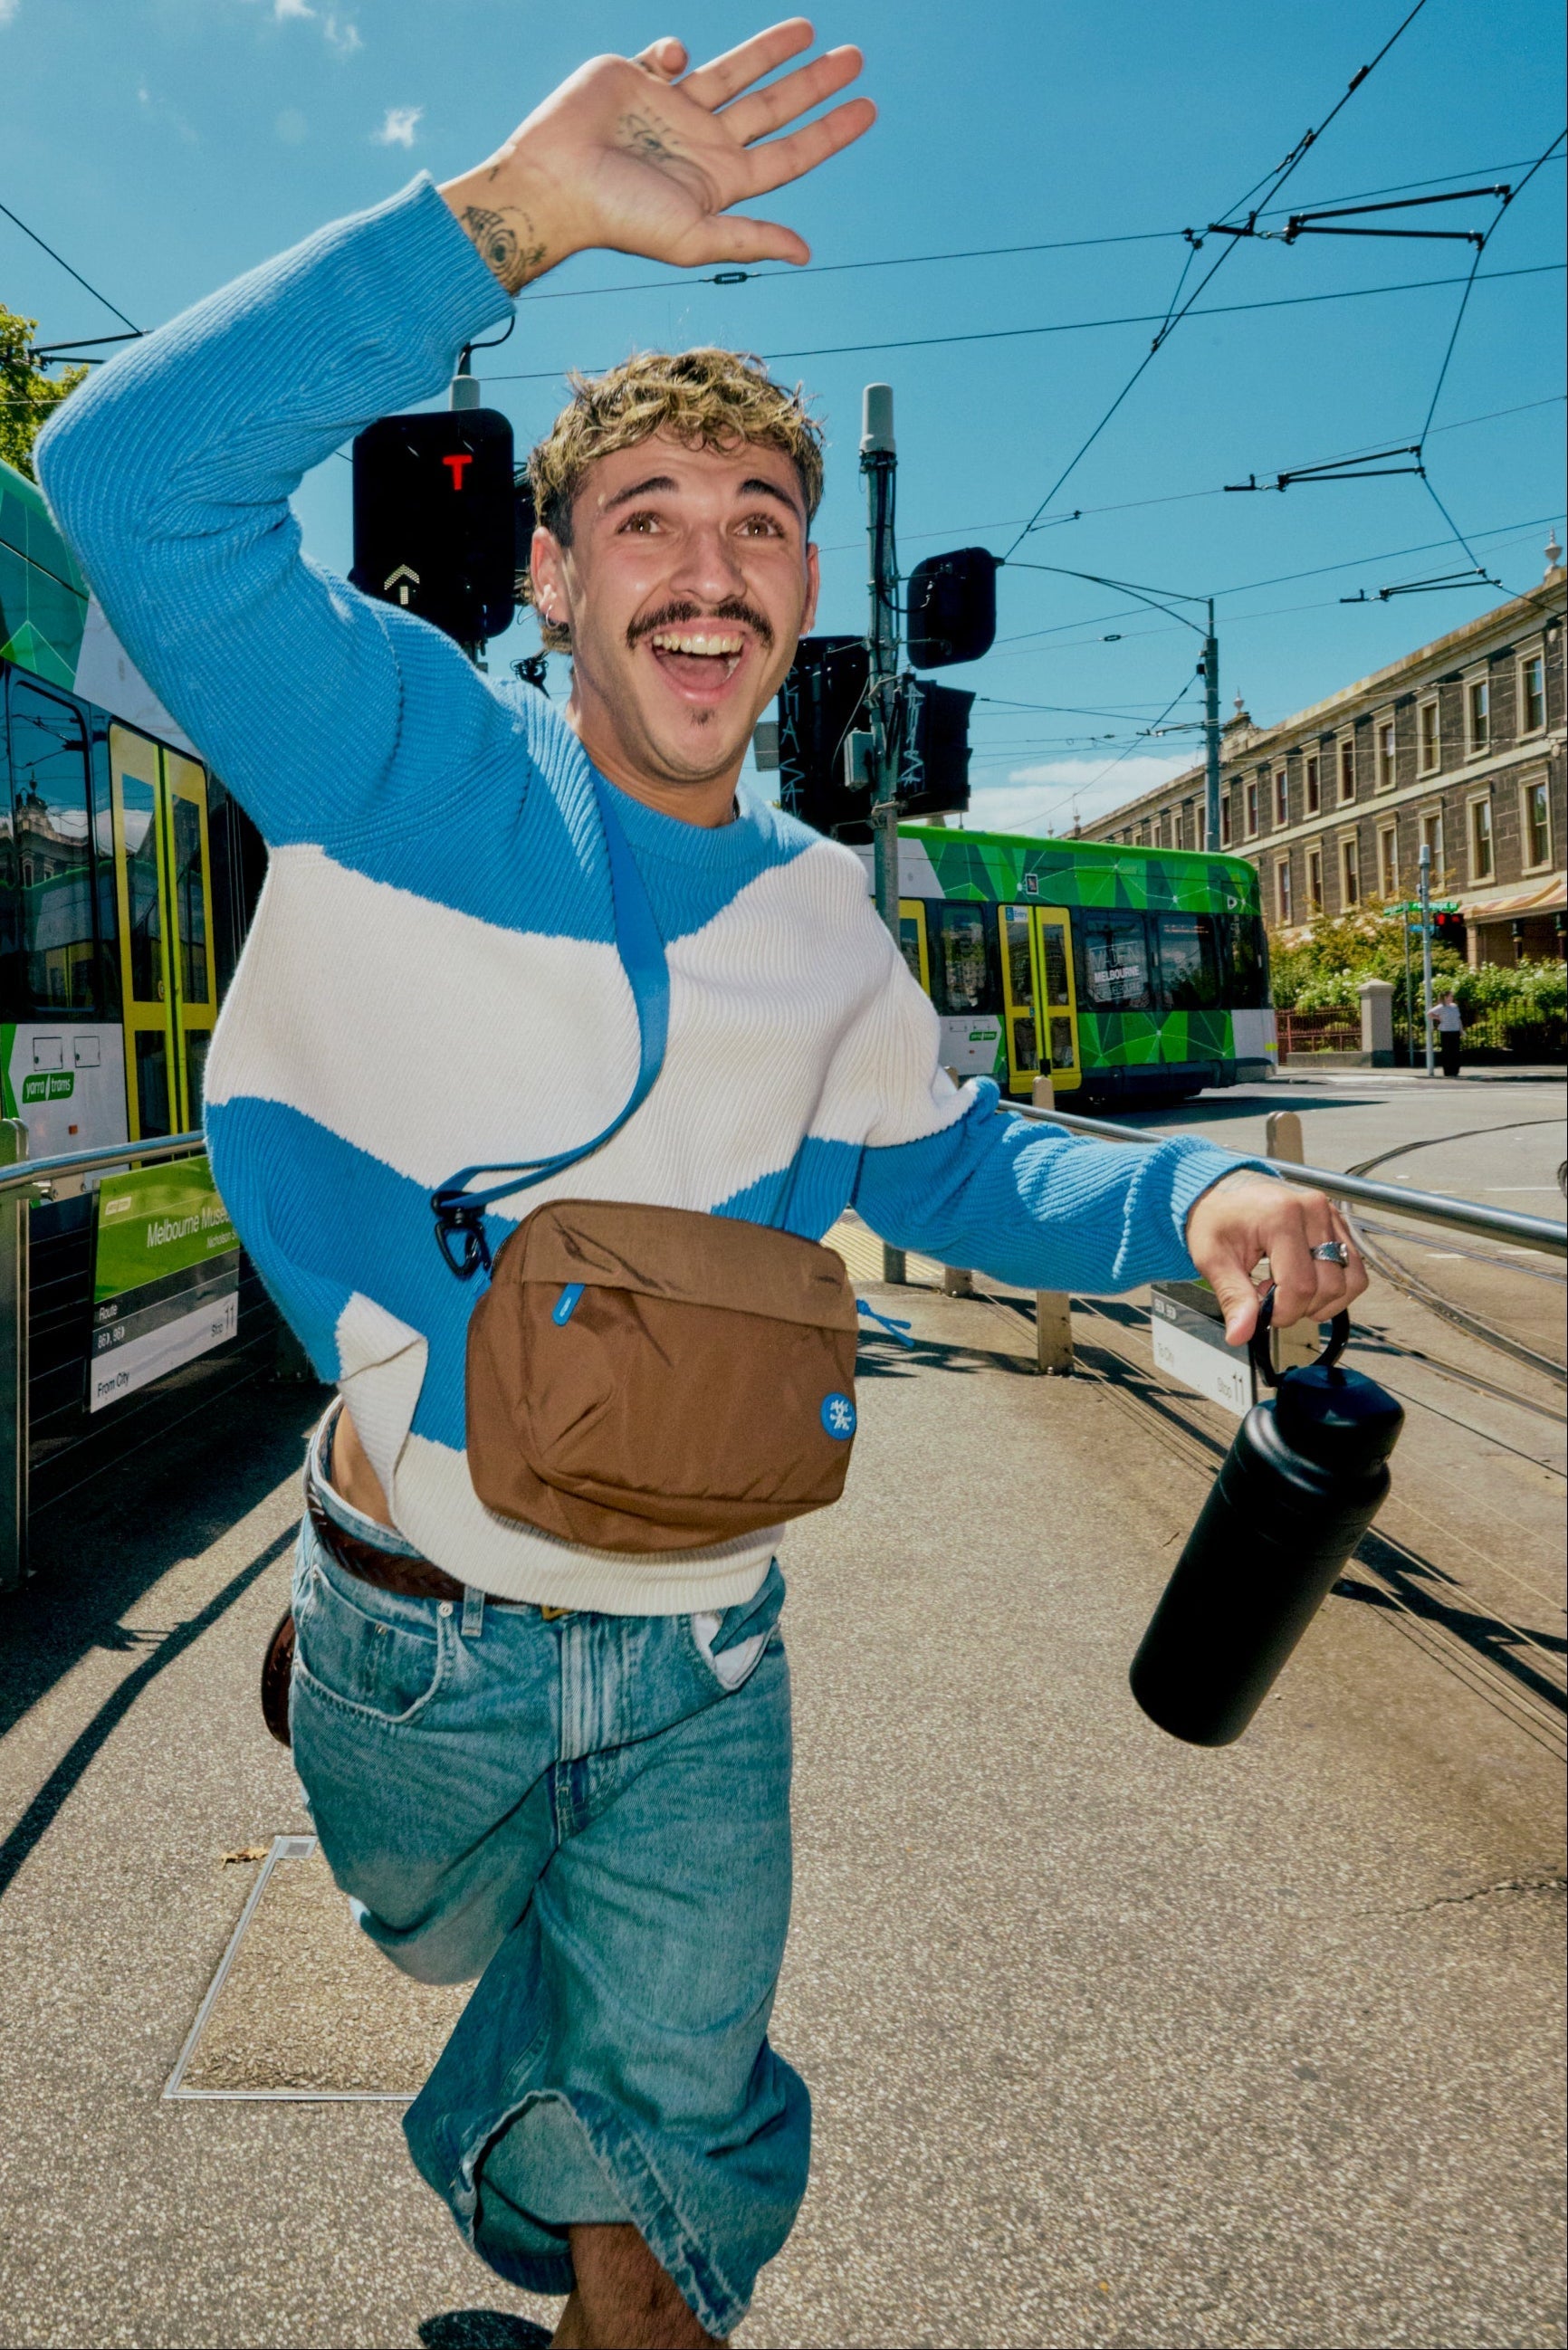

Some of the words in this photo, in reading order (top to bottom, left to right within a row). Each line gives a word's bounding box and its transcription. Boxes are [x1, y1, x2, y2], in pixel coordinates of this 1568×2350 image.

[1094, 966, 1140, 983] MELBOURNE
[26, 1081, 45, 1099] yarra
[51, 1078, 71, 1093] trams
[147, 1215, 199, 1248] Melbourne
[100, 1304, 118, 1321] Route
[225, 1302, 234, 1328] 11
[97, 1378, 115, 1398] From
[116, 1371, 130, 1389] City
